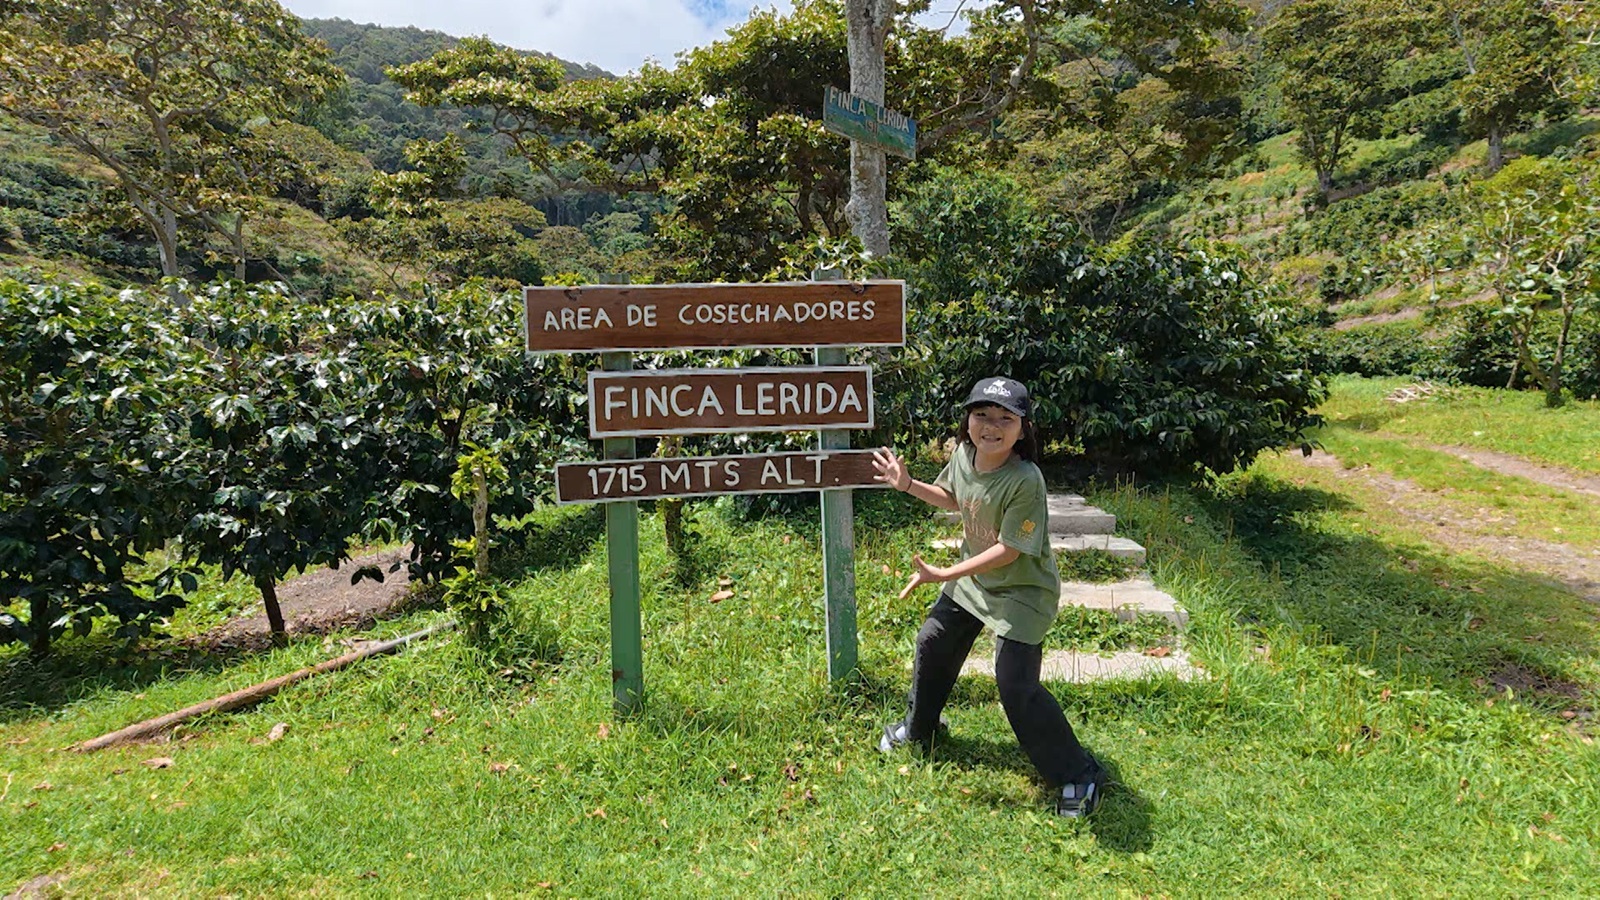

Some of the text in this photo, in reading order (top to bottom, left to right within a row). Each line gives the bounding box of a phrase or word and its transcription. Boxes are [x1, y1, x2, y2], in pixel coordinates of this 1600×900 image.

[829, 86, 909, 132] FINCA LERIDA
[543, 300, 876, 332] AREA DE COSECHADORES
[604, 382, 862, 421] FINCA LERIDA
[587, 455, 840, 496] 1715 MTS ALT.
